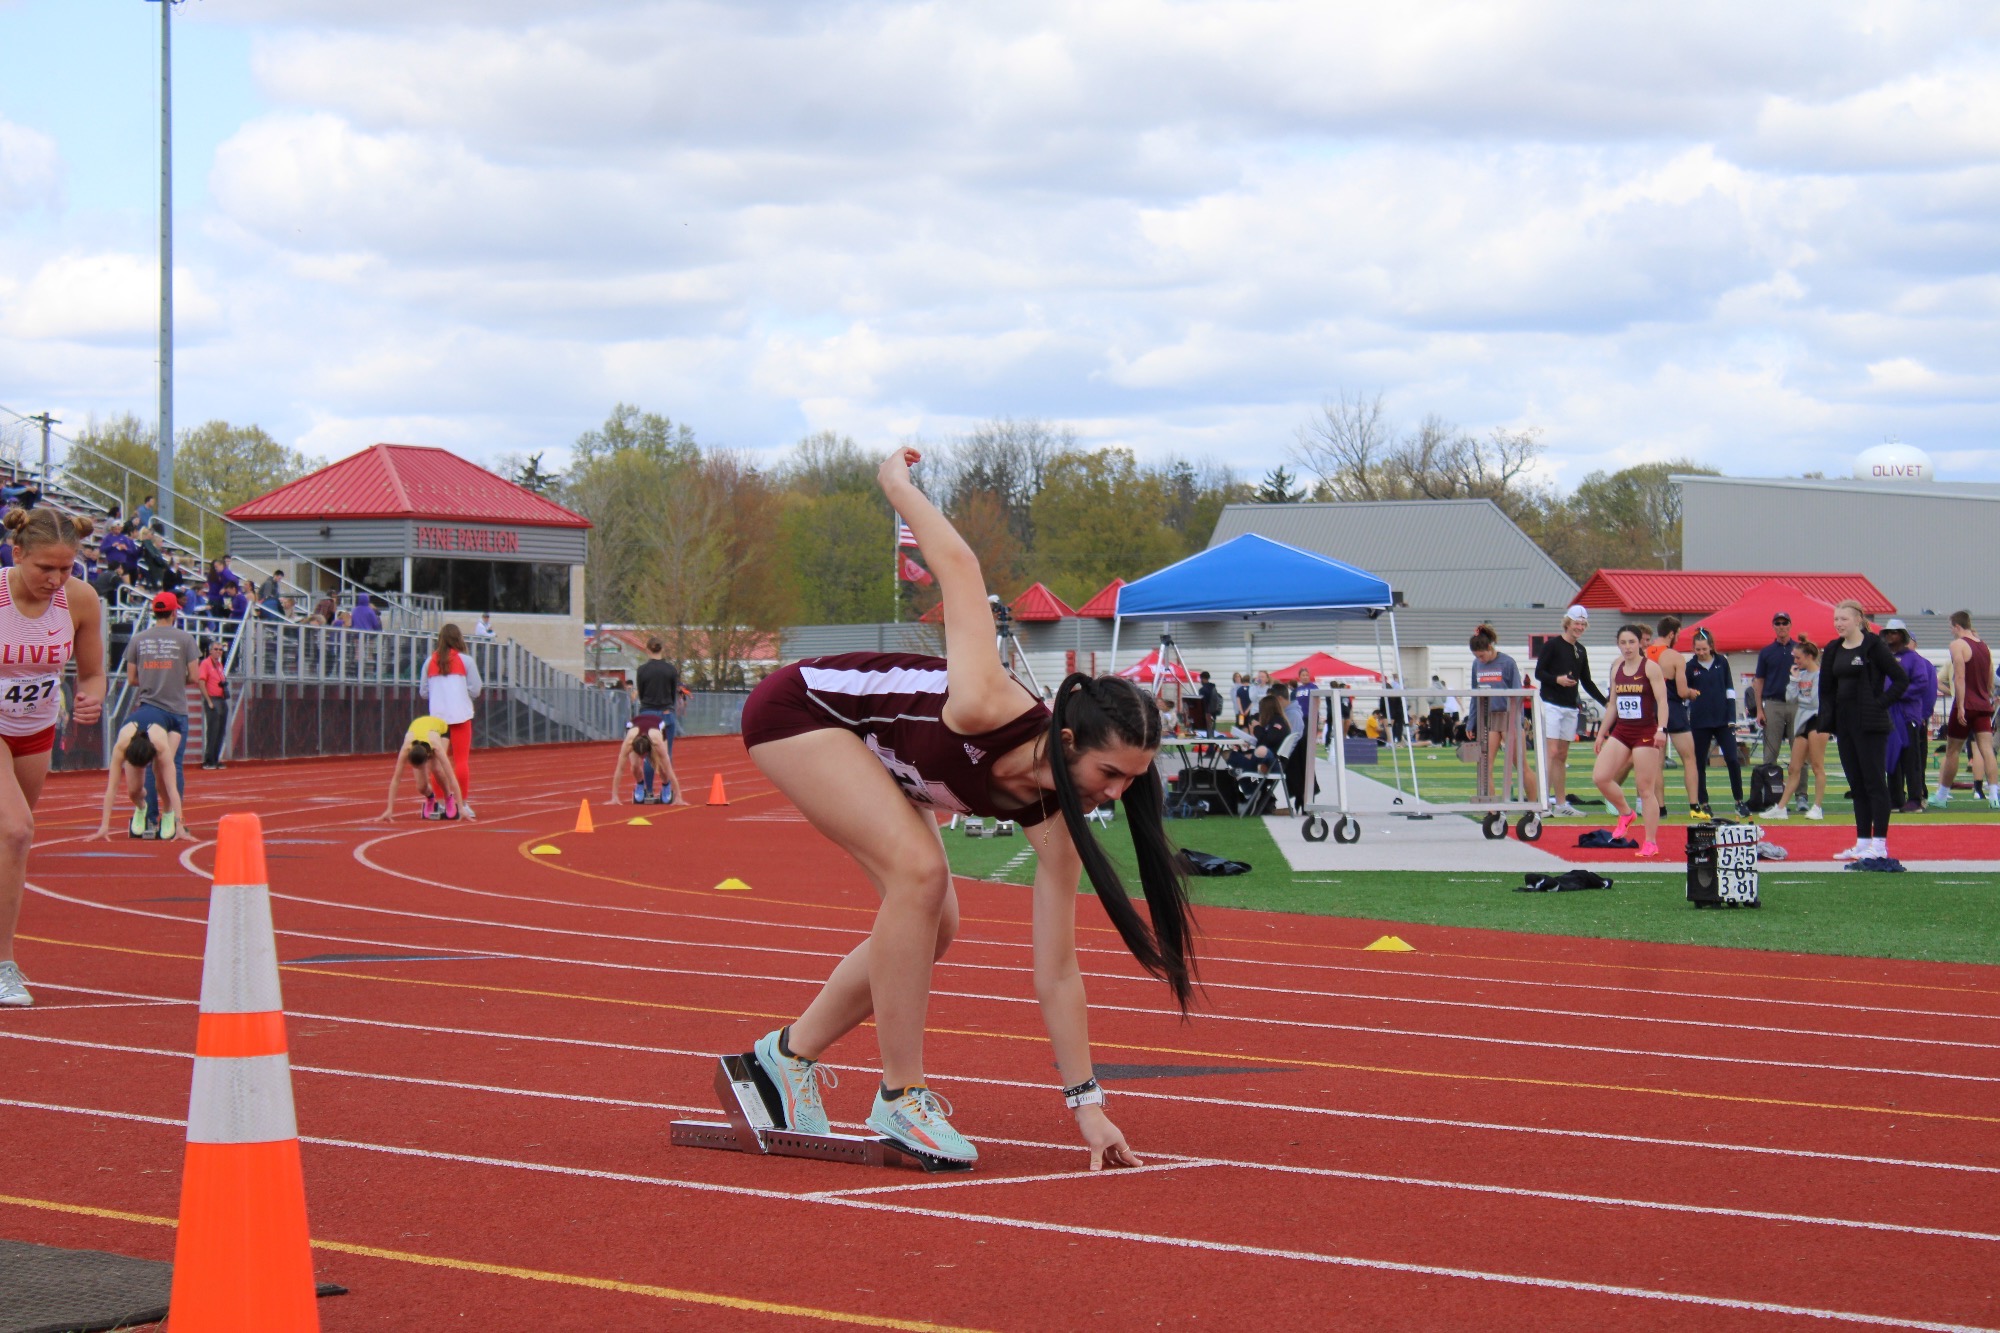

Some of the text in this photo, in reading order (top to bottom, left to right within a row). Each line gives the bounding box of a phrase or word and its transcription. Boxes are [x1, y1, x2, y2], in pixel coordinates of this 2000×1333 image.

[1872, 465, 1923, 477] OLIVET
[417, 526, 519, 553] PYNE PAVILION
[5, 679, 55, 703] 427
[1615, 684, 1644, 693] CALVIN
[1619, 700, 1638, 711] 199
